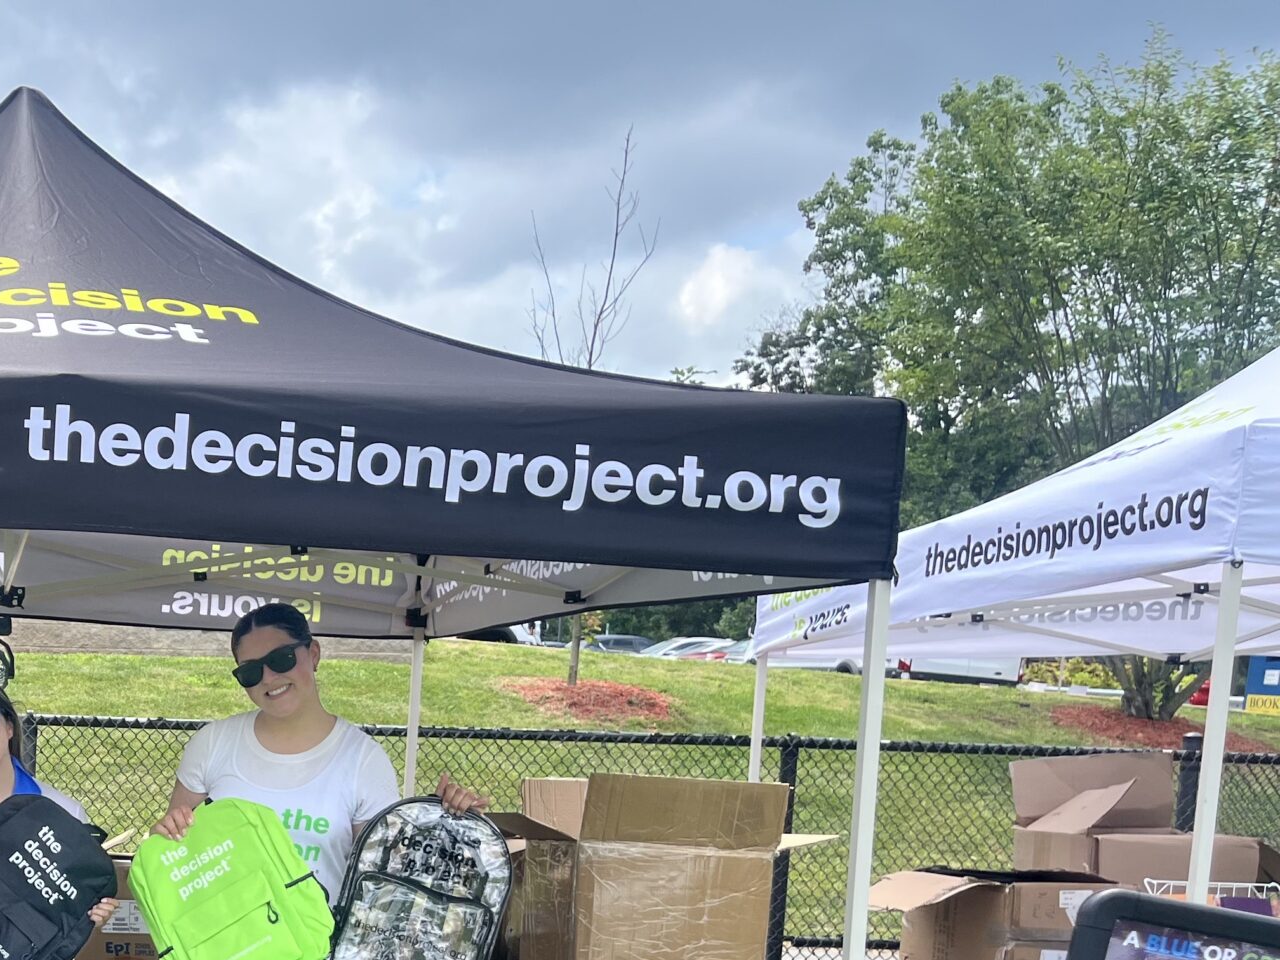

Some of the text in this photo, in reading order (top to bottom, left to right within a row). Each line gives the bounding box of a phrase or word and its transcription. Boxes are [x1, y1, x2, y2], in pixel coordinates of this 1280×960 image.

[23, 403, 842, 529] thedecisionproject.org
[924, 486, 1210, 579] thedecisionproject.org
[37, 824, 63, 854] the
[281, 808, 330, 835] the
[23, 838, 78, 901] decision
[160, 843, 189, 867] the
[169, 838, 235, 883] decision
[8, 851, 58, 905] project
[178, 859, 231, 901] project
[1122, 930, 1140, 949] A
[1145, 933, 1200, 960] BLUE
